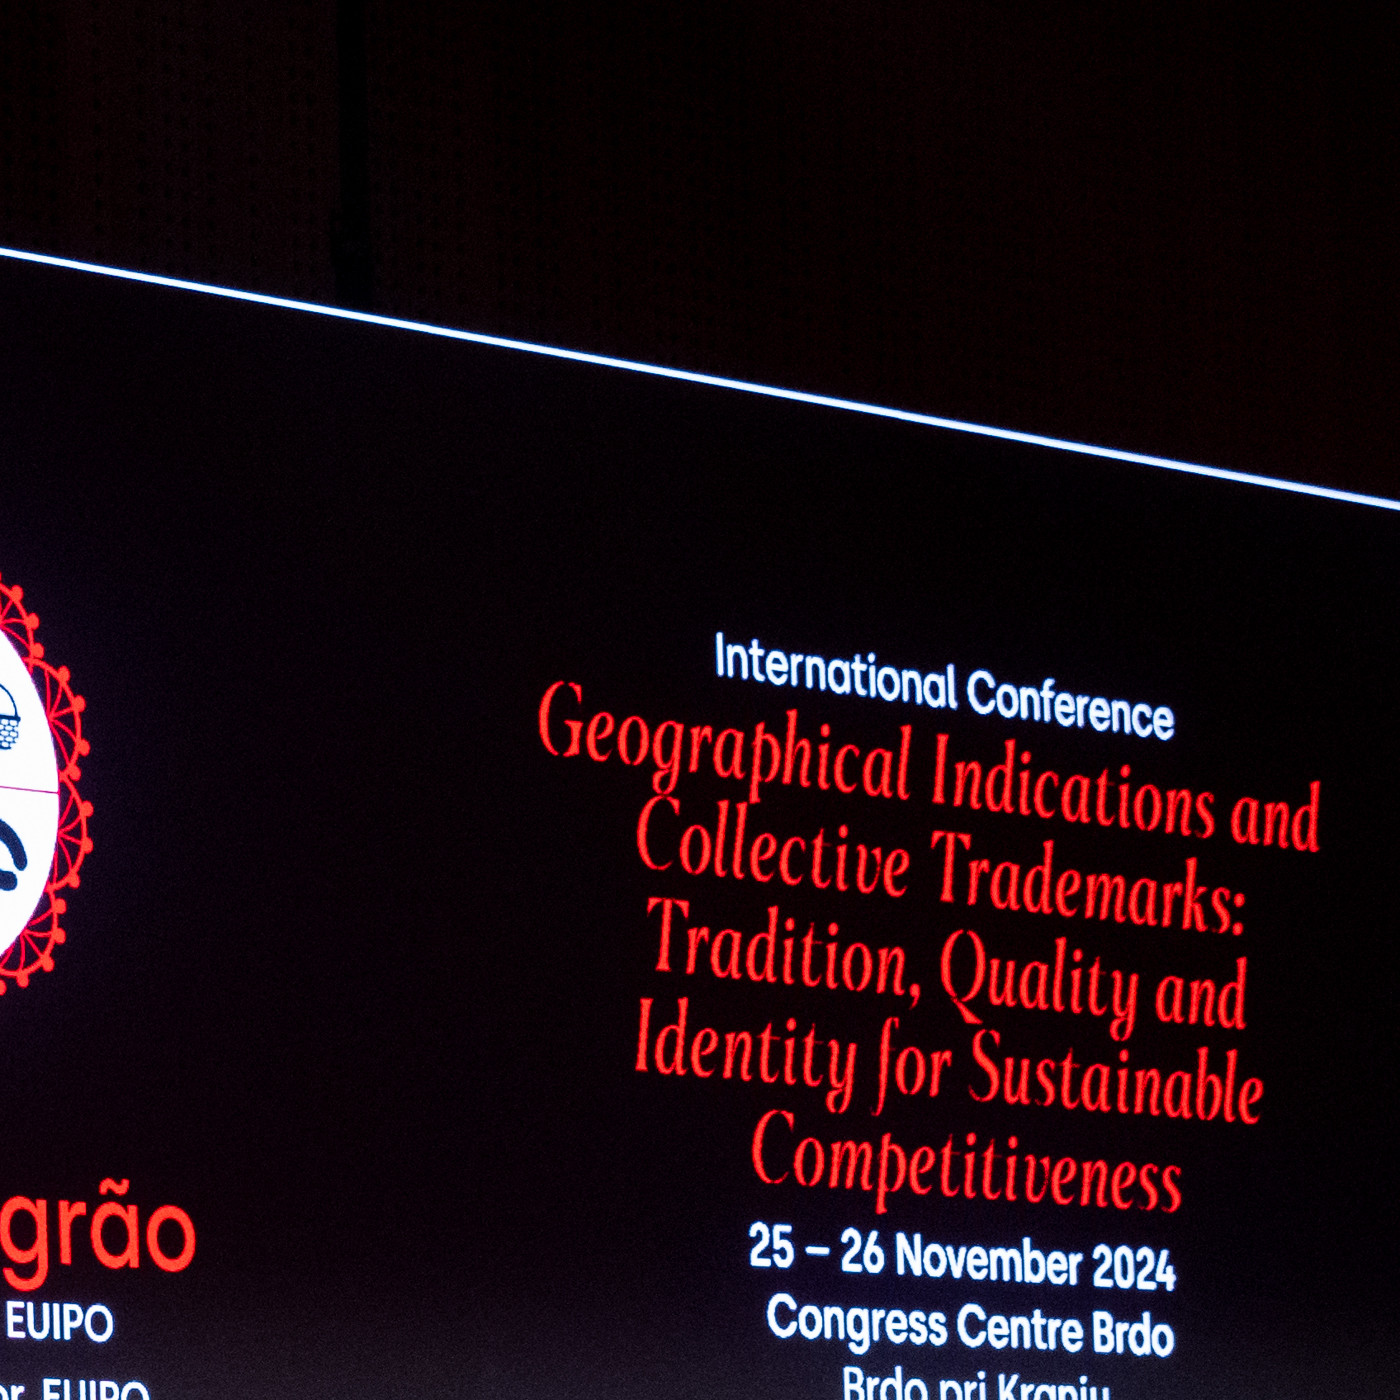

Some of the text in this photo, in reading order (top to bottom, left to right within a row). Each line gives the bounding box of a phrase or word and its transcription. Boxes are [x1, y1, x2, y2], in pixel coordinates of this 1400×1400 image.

[714, 630, 1176, 743] International Conference
[537, 679, 1322, 854] Geographical Indications and
[635, 793, 1246, 937] Collective Trademarks:
[645, 895, 1248, 1045] Tradition, Quality and
[634, 995, 1265, 1126] Identity for Sustainable
[750, 1108, 1183, 1216] Competitiveness
[747, 1219, 796, 1270] 25
[839, 1225, 887, 1275] 26
[894, 1230, 1085, 1288] November
[1090, 1241, 1179, 1293] 2024
[4, 1299, 115, 1345] EUIPO
[764, 1291, 1177, 1360] Congress Centre Brdo
